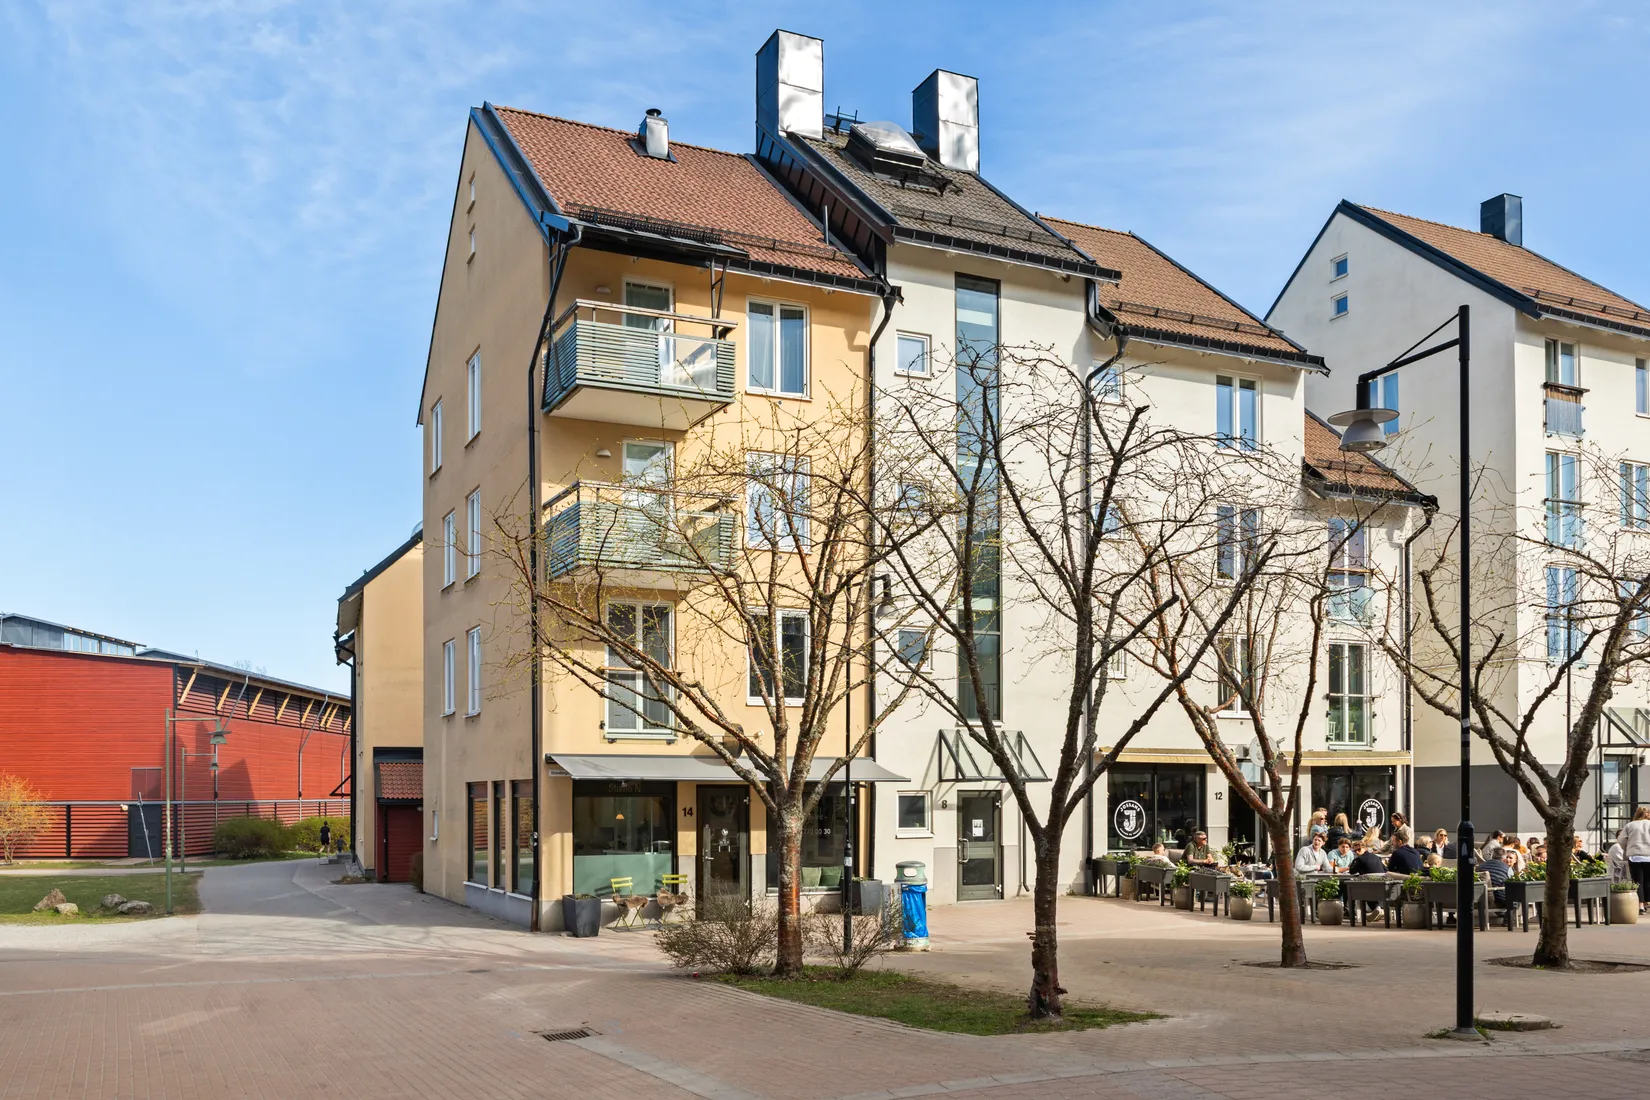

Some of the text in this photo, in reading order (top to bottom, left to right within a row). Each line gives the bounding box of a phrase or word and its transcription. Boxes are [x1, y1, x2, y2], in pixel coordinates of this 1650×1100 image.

[1214, 791, 1223, 801] 12
[941, 799, 948, 810] 8
[682, 806, 694, 817] 14
